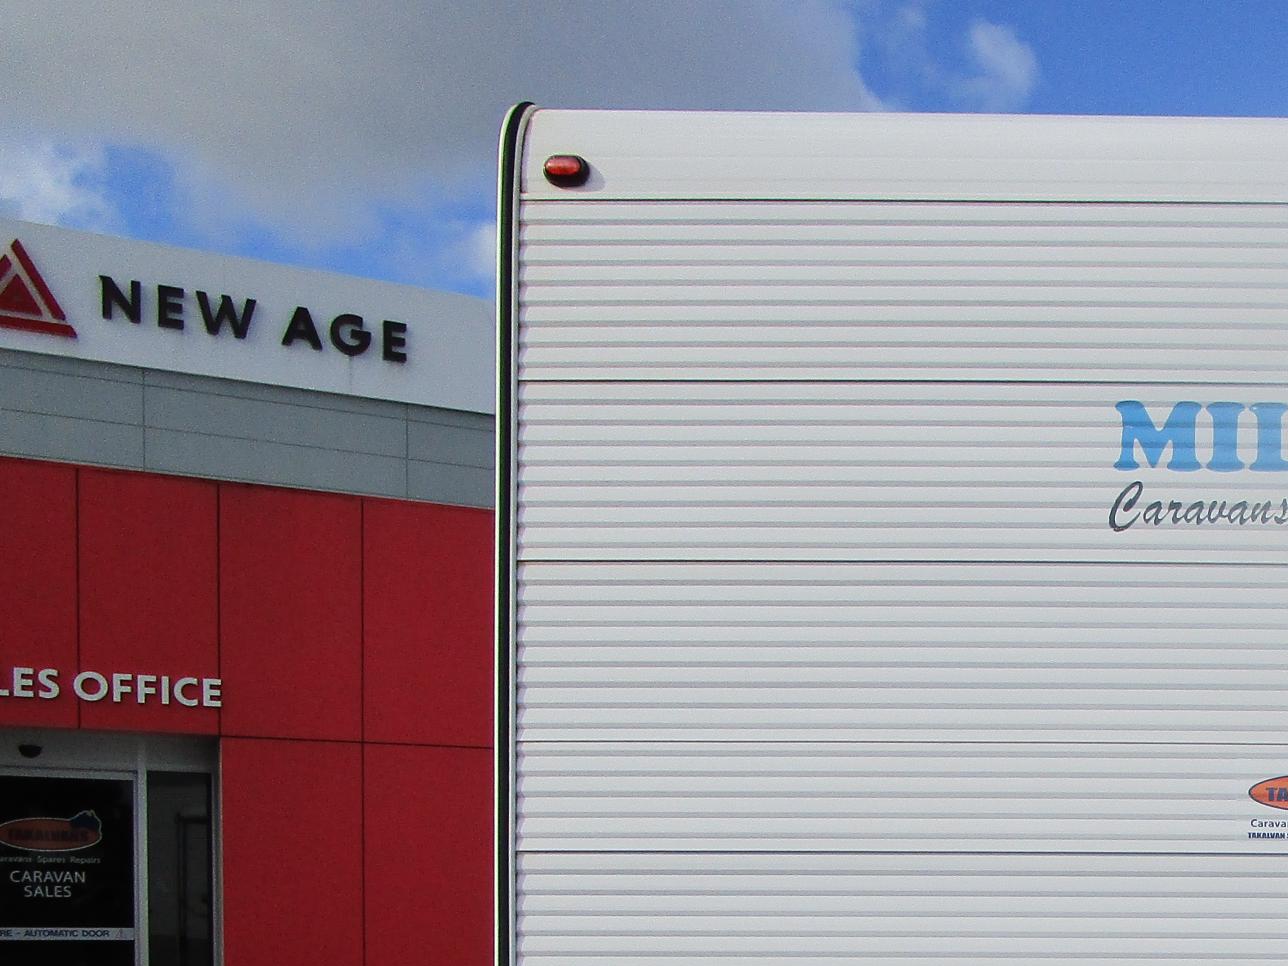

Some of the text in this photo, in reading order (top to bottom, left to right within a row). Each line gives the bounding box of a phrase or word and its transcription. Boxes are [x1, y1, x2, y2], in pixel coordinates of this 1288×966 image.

[99, 275, 407, 362] NEW AGE
[73, 672, 222, 707] OFFICE
[9, 870, 86, 883] CARAVAN
[23, 885, 72, 898] SALES
[23, 930, 79, 938] AUTOMATIC
[81, 930, 110, 938] DOOR
